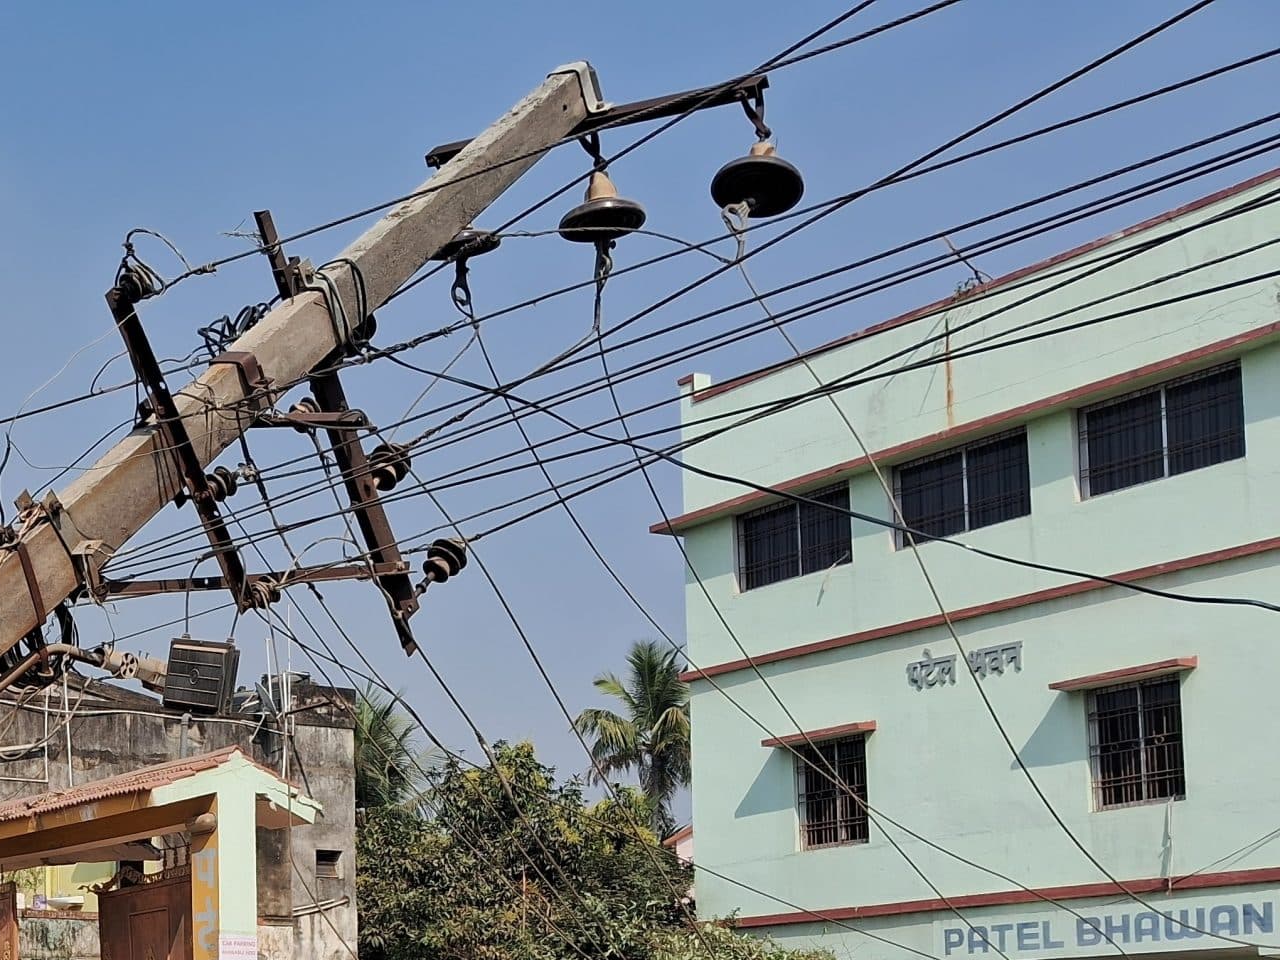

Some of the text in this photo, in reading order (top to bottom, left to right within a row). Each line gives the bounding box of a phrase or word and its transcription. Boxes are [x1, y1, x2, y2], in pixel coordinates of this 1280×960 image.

[906, 640, 1023, 692] पटेल भवन
[945, 902, 1273, 956] PATEL BHAWAN
